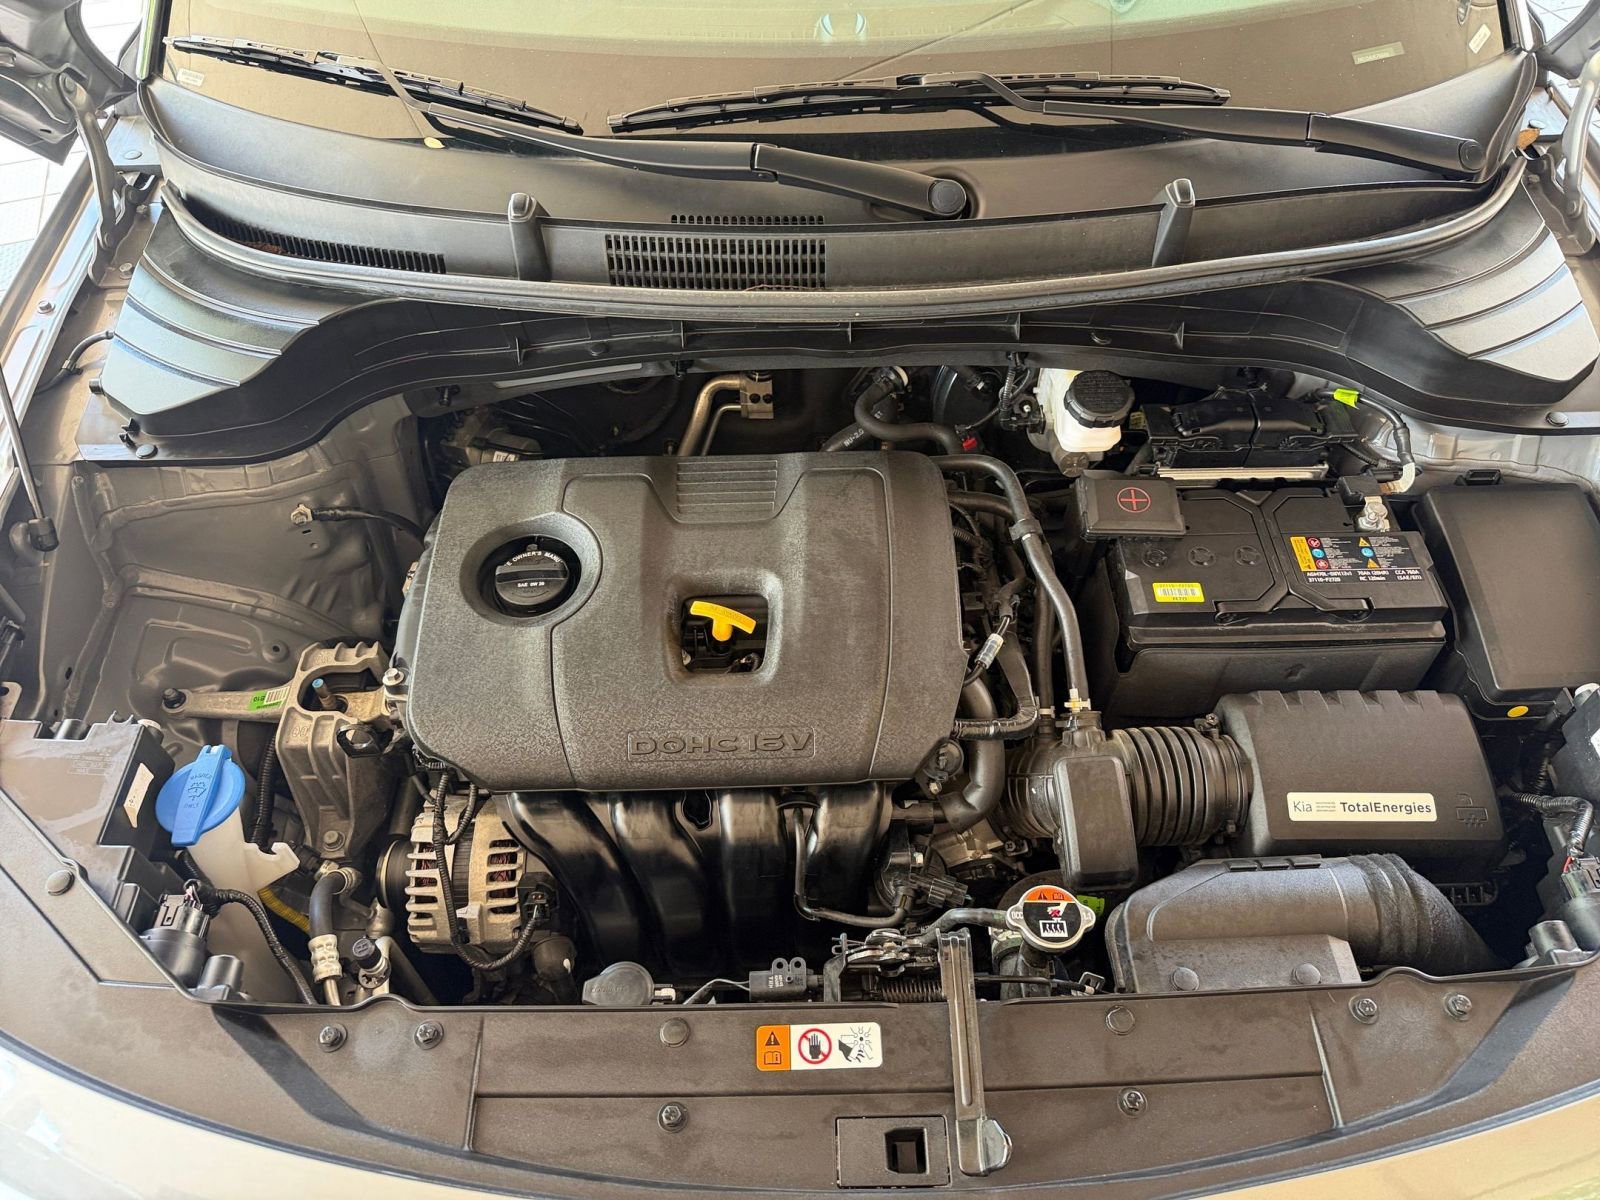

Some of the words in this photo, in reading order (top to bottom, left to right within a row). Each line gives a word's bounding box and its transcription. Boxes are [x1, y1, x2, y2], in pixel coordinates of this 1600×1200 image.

[512, 550, 542, 562] OWNER'S
[544, 551, 564, 563] MANU
[631, 735, 738, 755] DOHC
[752, 732, 812, 752] 16V
[1292, 800, 1312, 813] Kia
[1339, 801, 1432, 815] TotalEnergies
